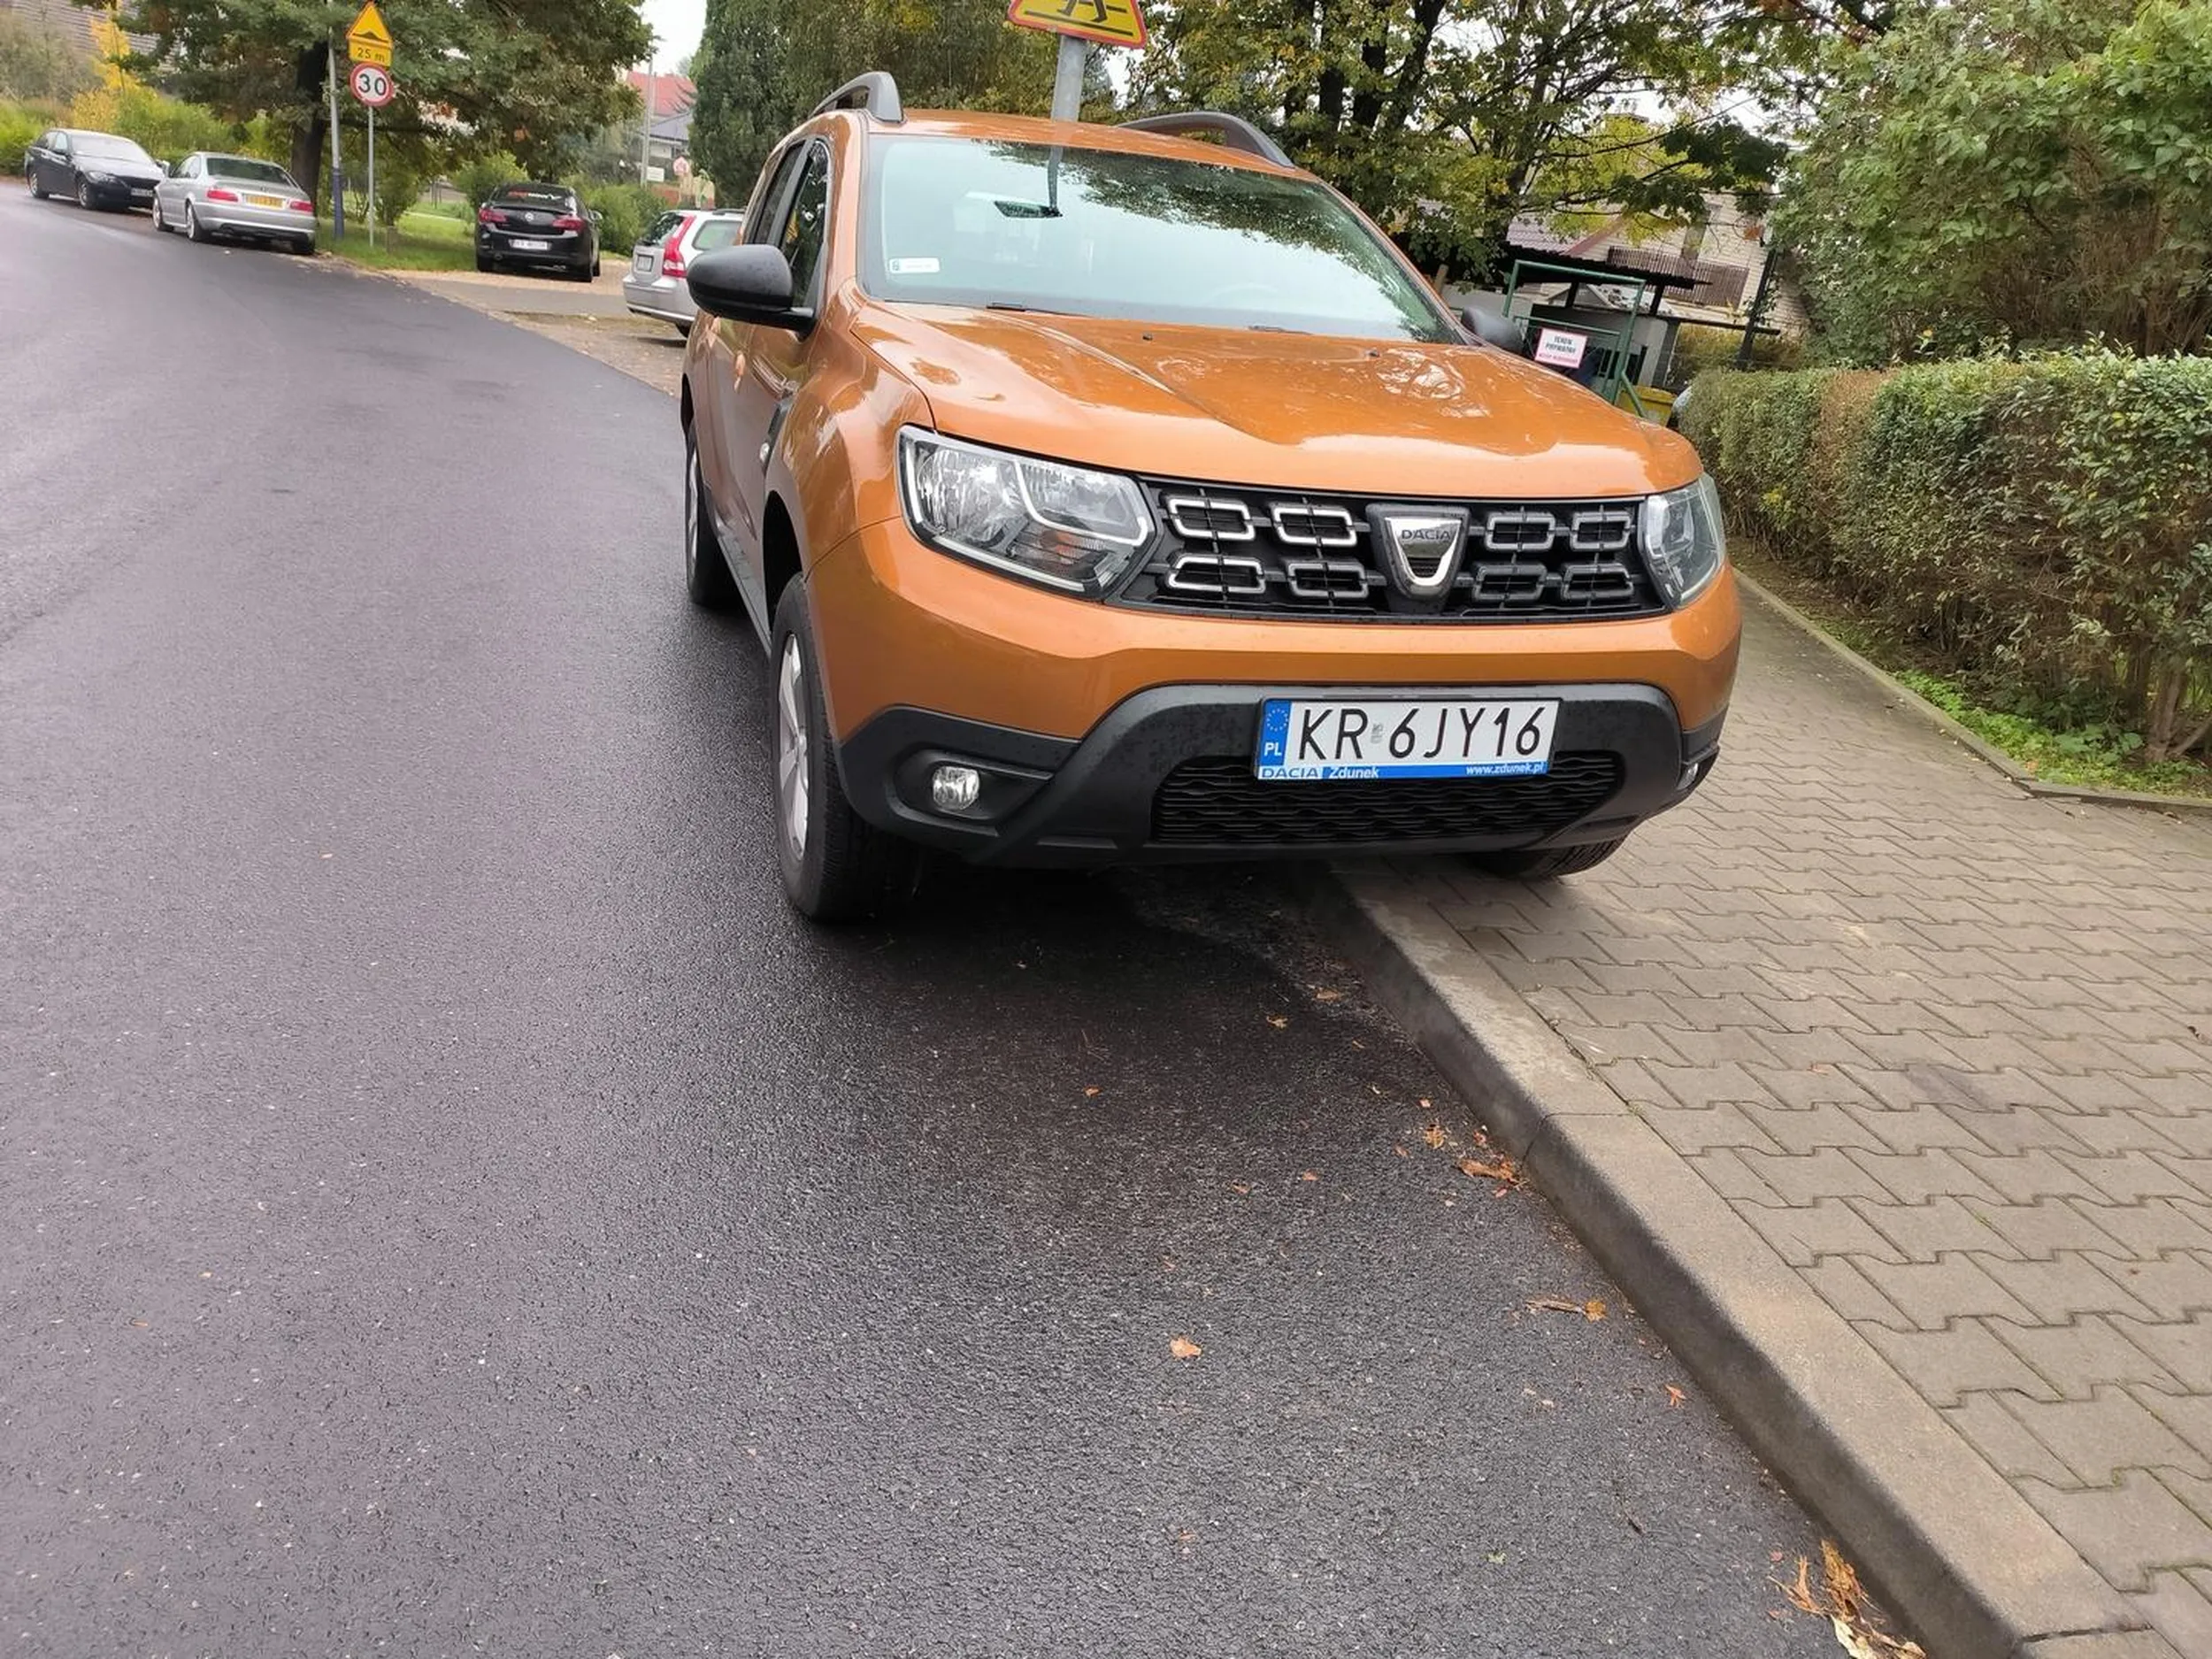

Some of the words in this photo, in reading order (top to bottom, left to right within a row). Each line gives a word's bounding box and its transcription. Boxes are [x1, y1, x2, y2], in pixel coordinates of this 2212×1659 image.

[357, 47, 371, 59] 25
[374, 53, 385, 62] m
[358, 73, 387, 96] 30
[1401, 529, 1451, 541] DACIA
[1298, 707, 1369, 761] KR
[1388, 706, 1547, 760] 6JY16
[1263, 741, 1283, 757] PL
[1261, 766, 1319, 779] DACIA
[1328, 765, 1380, 779] Zdunek
[1465, 761, 1546, 776] www.zdunek.pl
